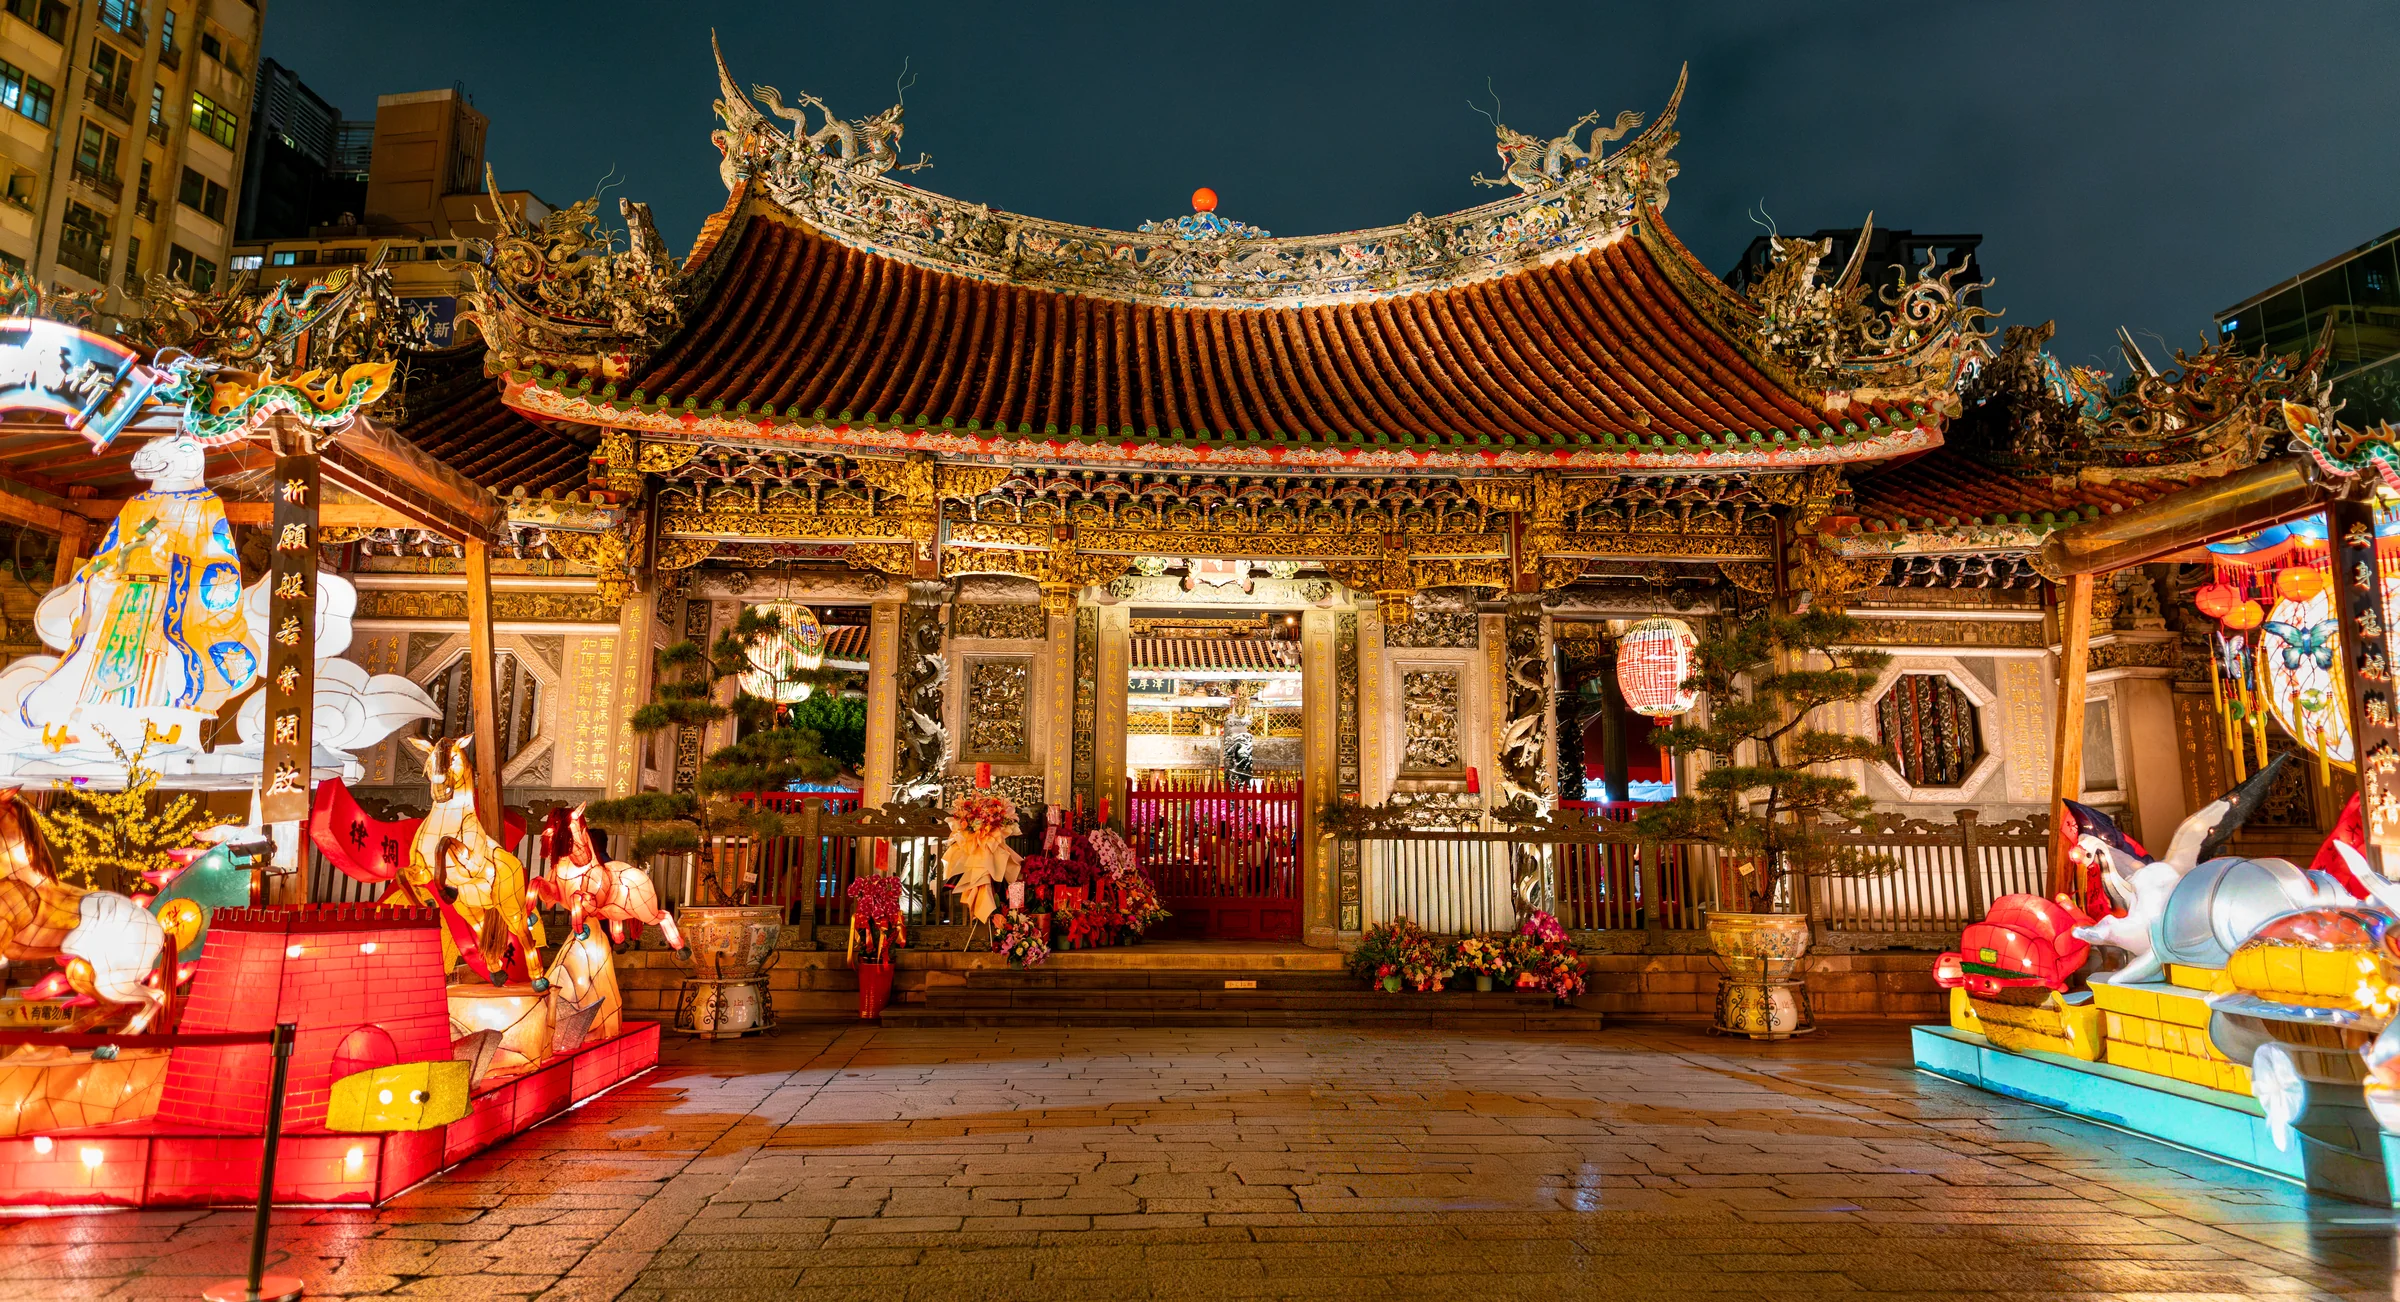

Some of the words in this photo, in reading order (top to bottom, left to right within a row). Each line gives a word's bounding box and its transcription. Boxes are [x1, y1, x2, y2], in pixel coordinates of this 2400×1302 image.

[614, 605, 642, 799] 慈雲法雨神靈廣被仰全
[31, 1005, 73, 1020] 有電勿觸
